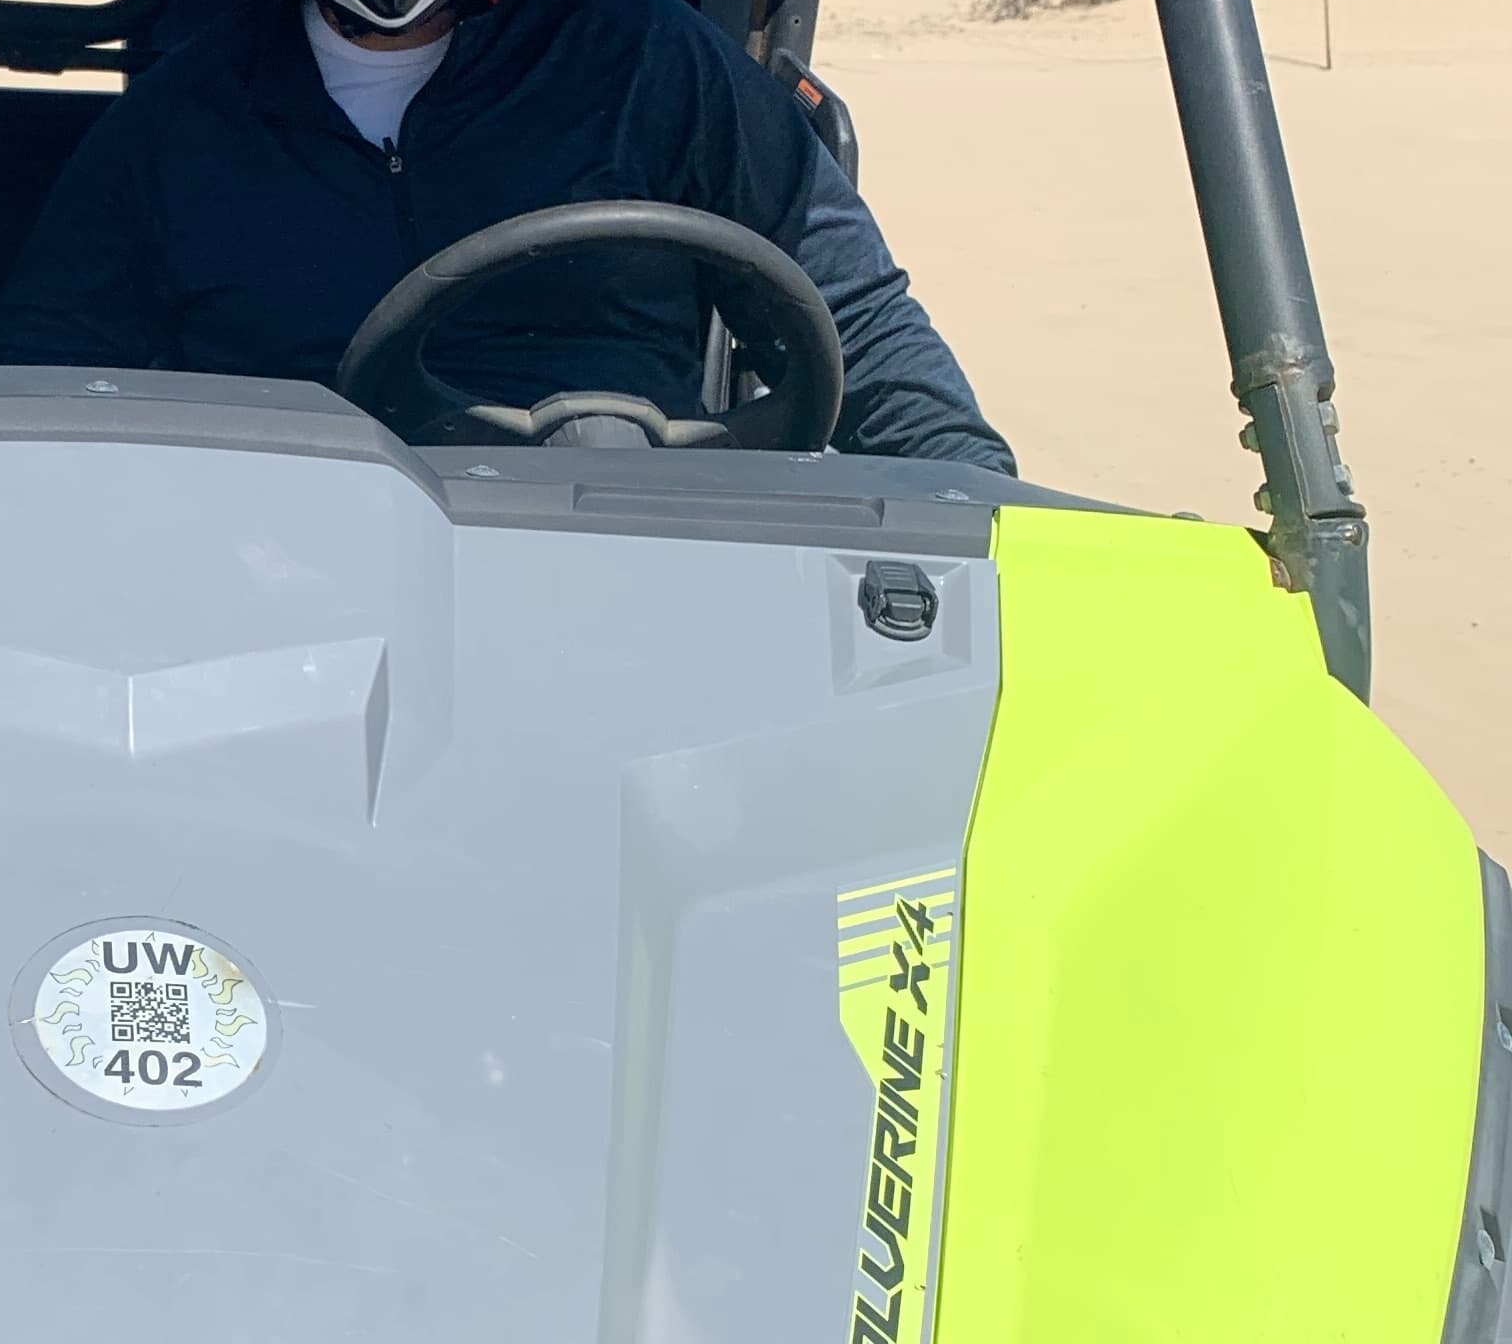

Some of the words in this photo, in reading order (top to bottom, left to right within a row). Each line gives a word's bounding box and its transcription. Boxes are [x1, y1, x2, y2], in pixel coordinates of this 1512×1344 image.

[102, 940, 195, 975] UW
[889, 896, 935, 1015] X4
[103, 1049, 203, 1087] 402
